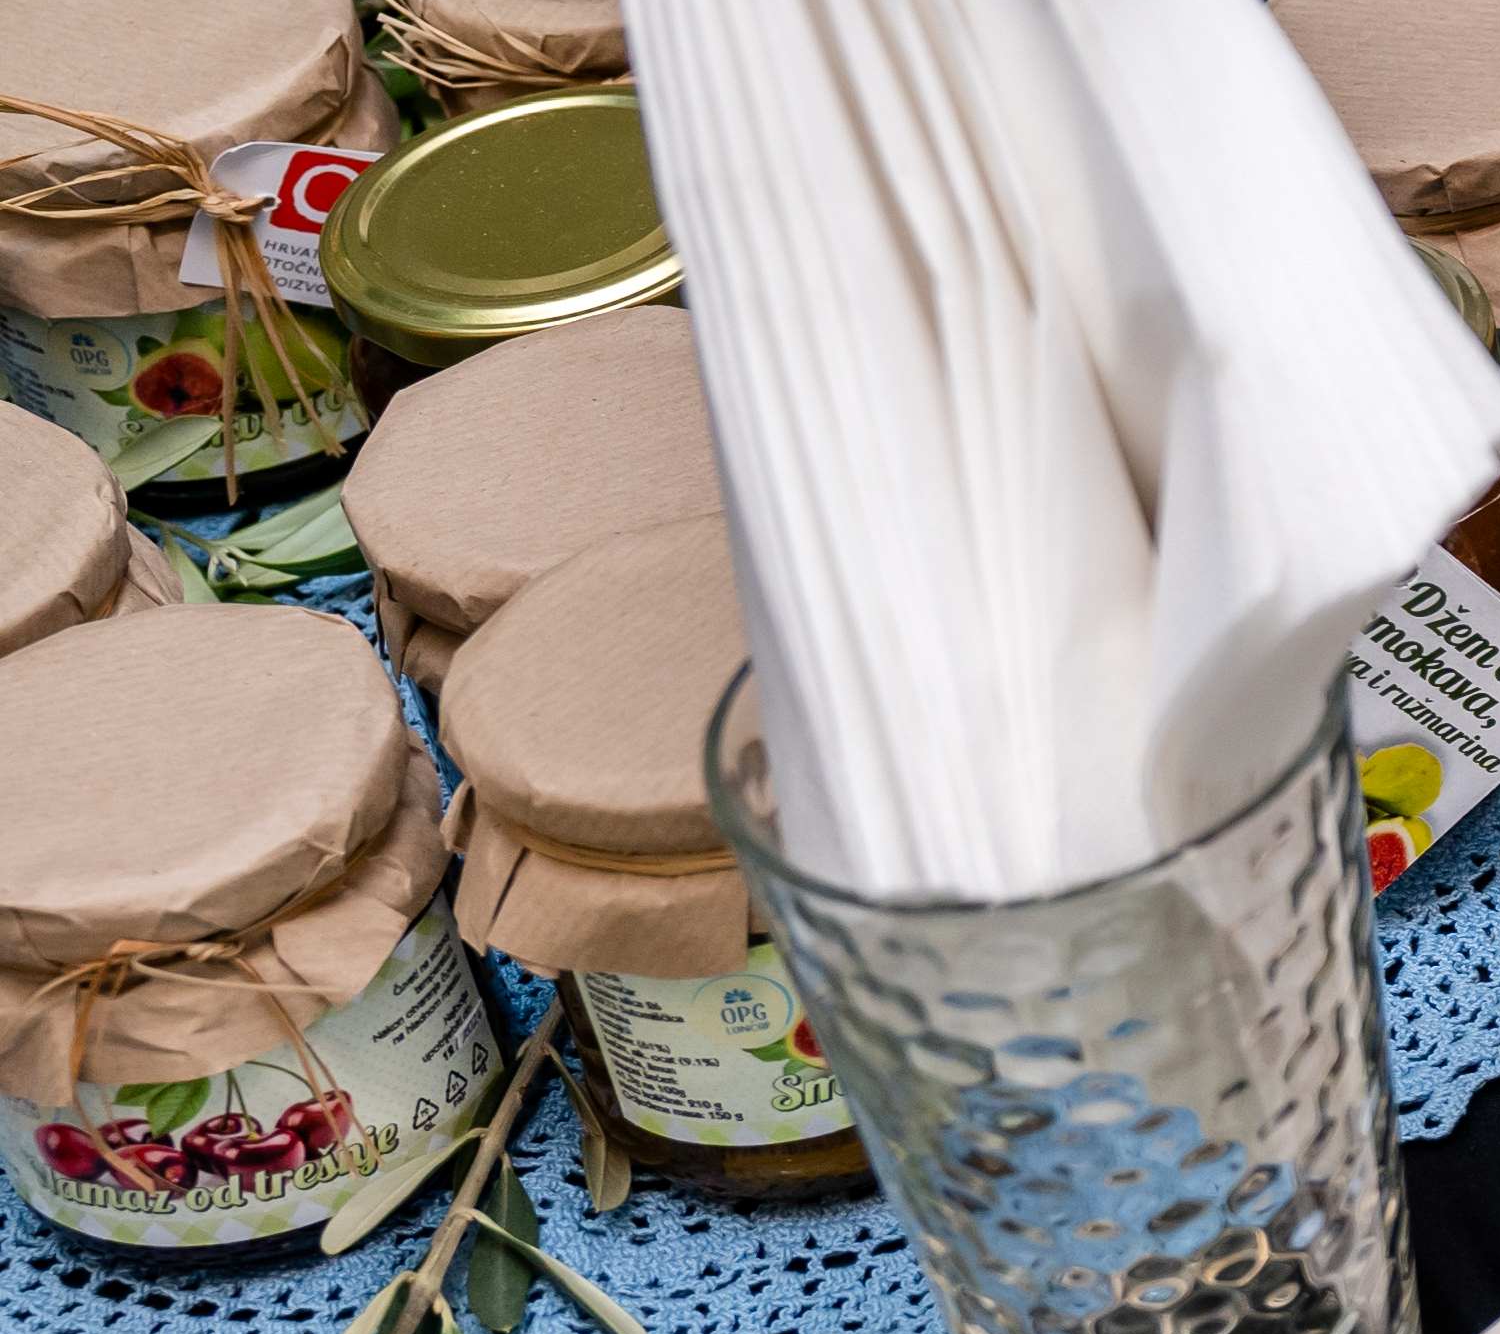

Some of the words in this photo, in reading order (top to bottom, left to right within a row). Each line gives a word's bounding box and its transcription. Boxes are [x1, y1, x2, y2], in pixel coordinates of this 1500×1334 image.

[1400, 580, 1494, 668] Džem
[1362, 612, 1500, 729] mokava,
[720, 1003, 768, 1025] OPG
[184, 1175, 247, 1212] od
